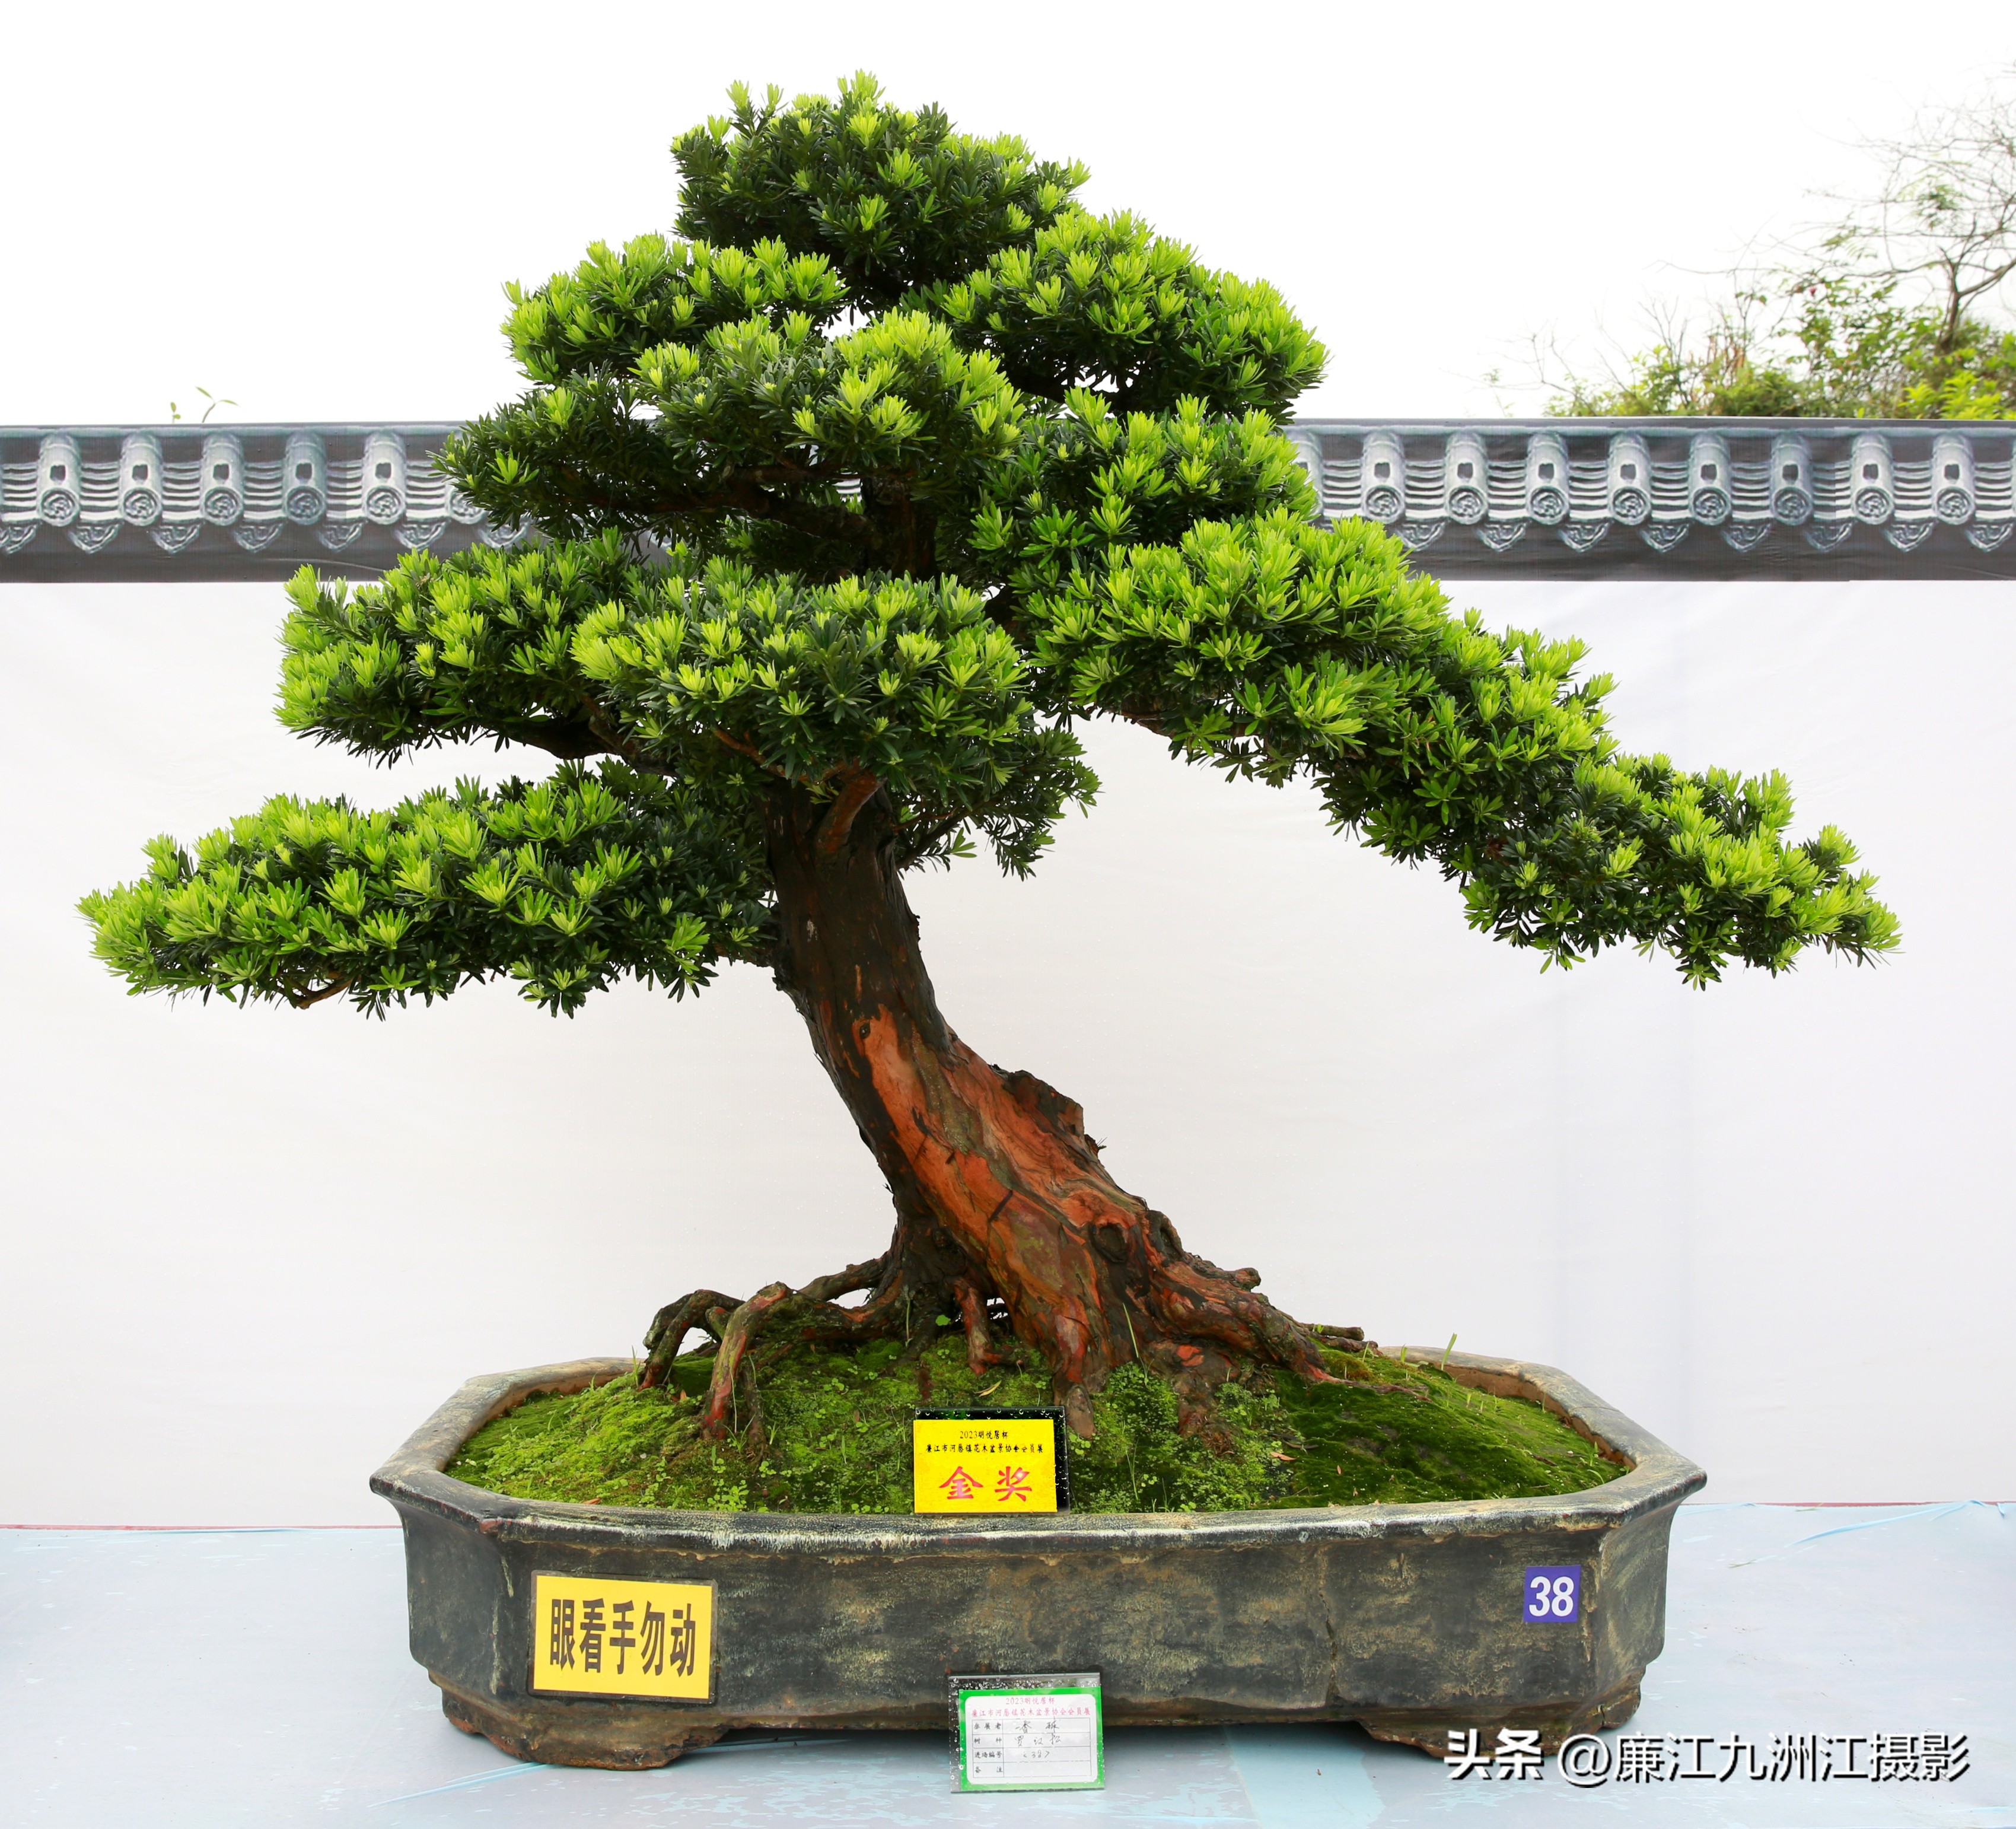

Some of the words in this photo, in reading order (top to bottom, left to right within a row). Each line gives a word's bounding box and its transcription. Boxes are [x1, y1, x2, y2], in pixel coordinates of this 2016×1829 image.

[939, 1466, 1032, 1502] 金奖
[1528, 1576, 1575, 1617] 38
[549, 1598, 696, 1677] 眼看手勿动
